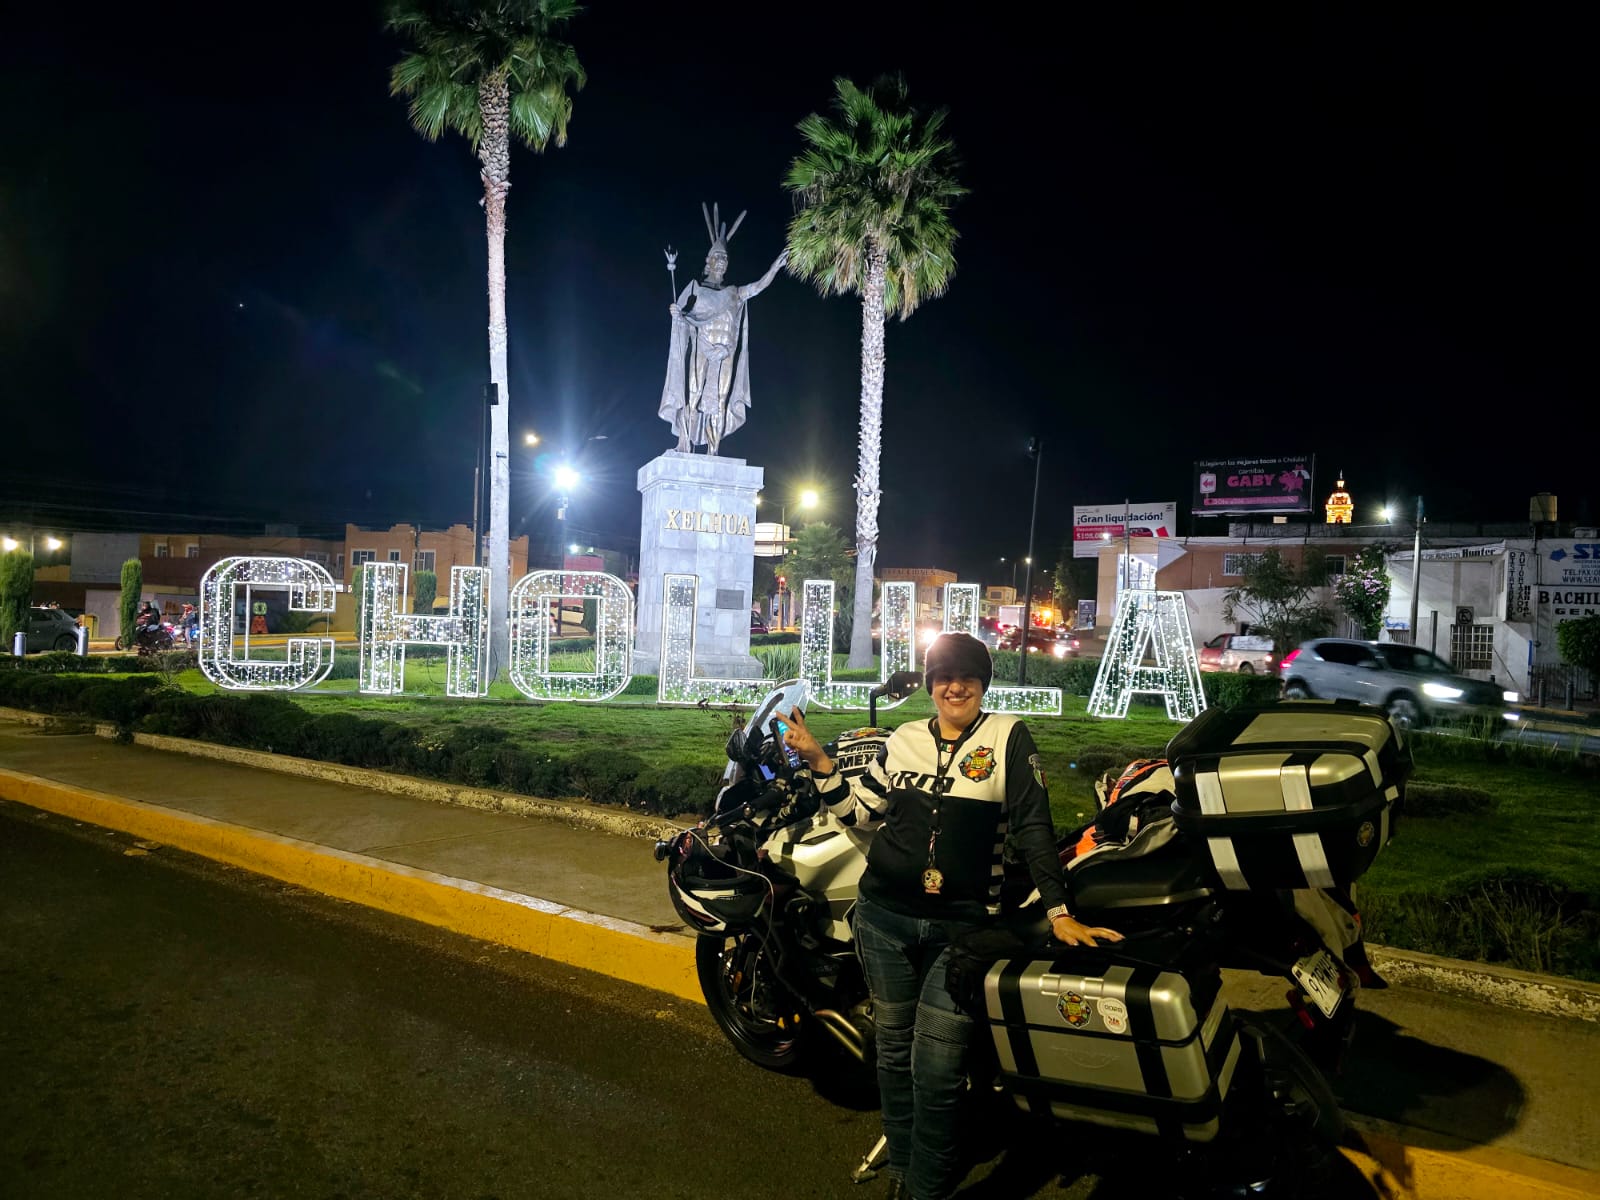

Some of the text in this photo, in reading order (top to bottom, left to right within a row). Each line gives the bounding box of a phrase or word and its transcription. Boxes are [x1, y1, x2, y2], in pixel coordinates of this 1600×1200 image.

[1226, 474, 1275, 487] GABY
[664, 508, 753, 536] XELHUA
[1077, 511, 1163, 525] ¡Gran liquidación!
[1462, 547, 1496, 558] Hunter
